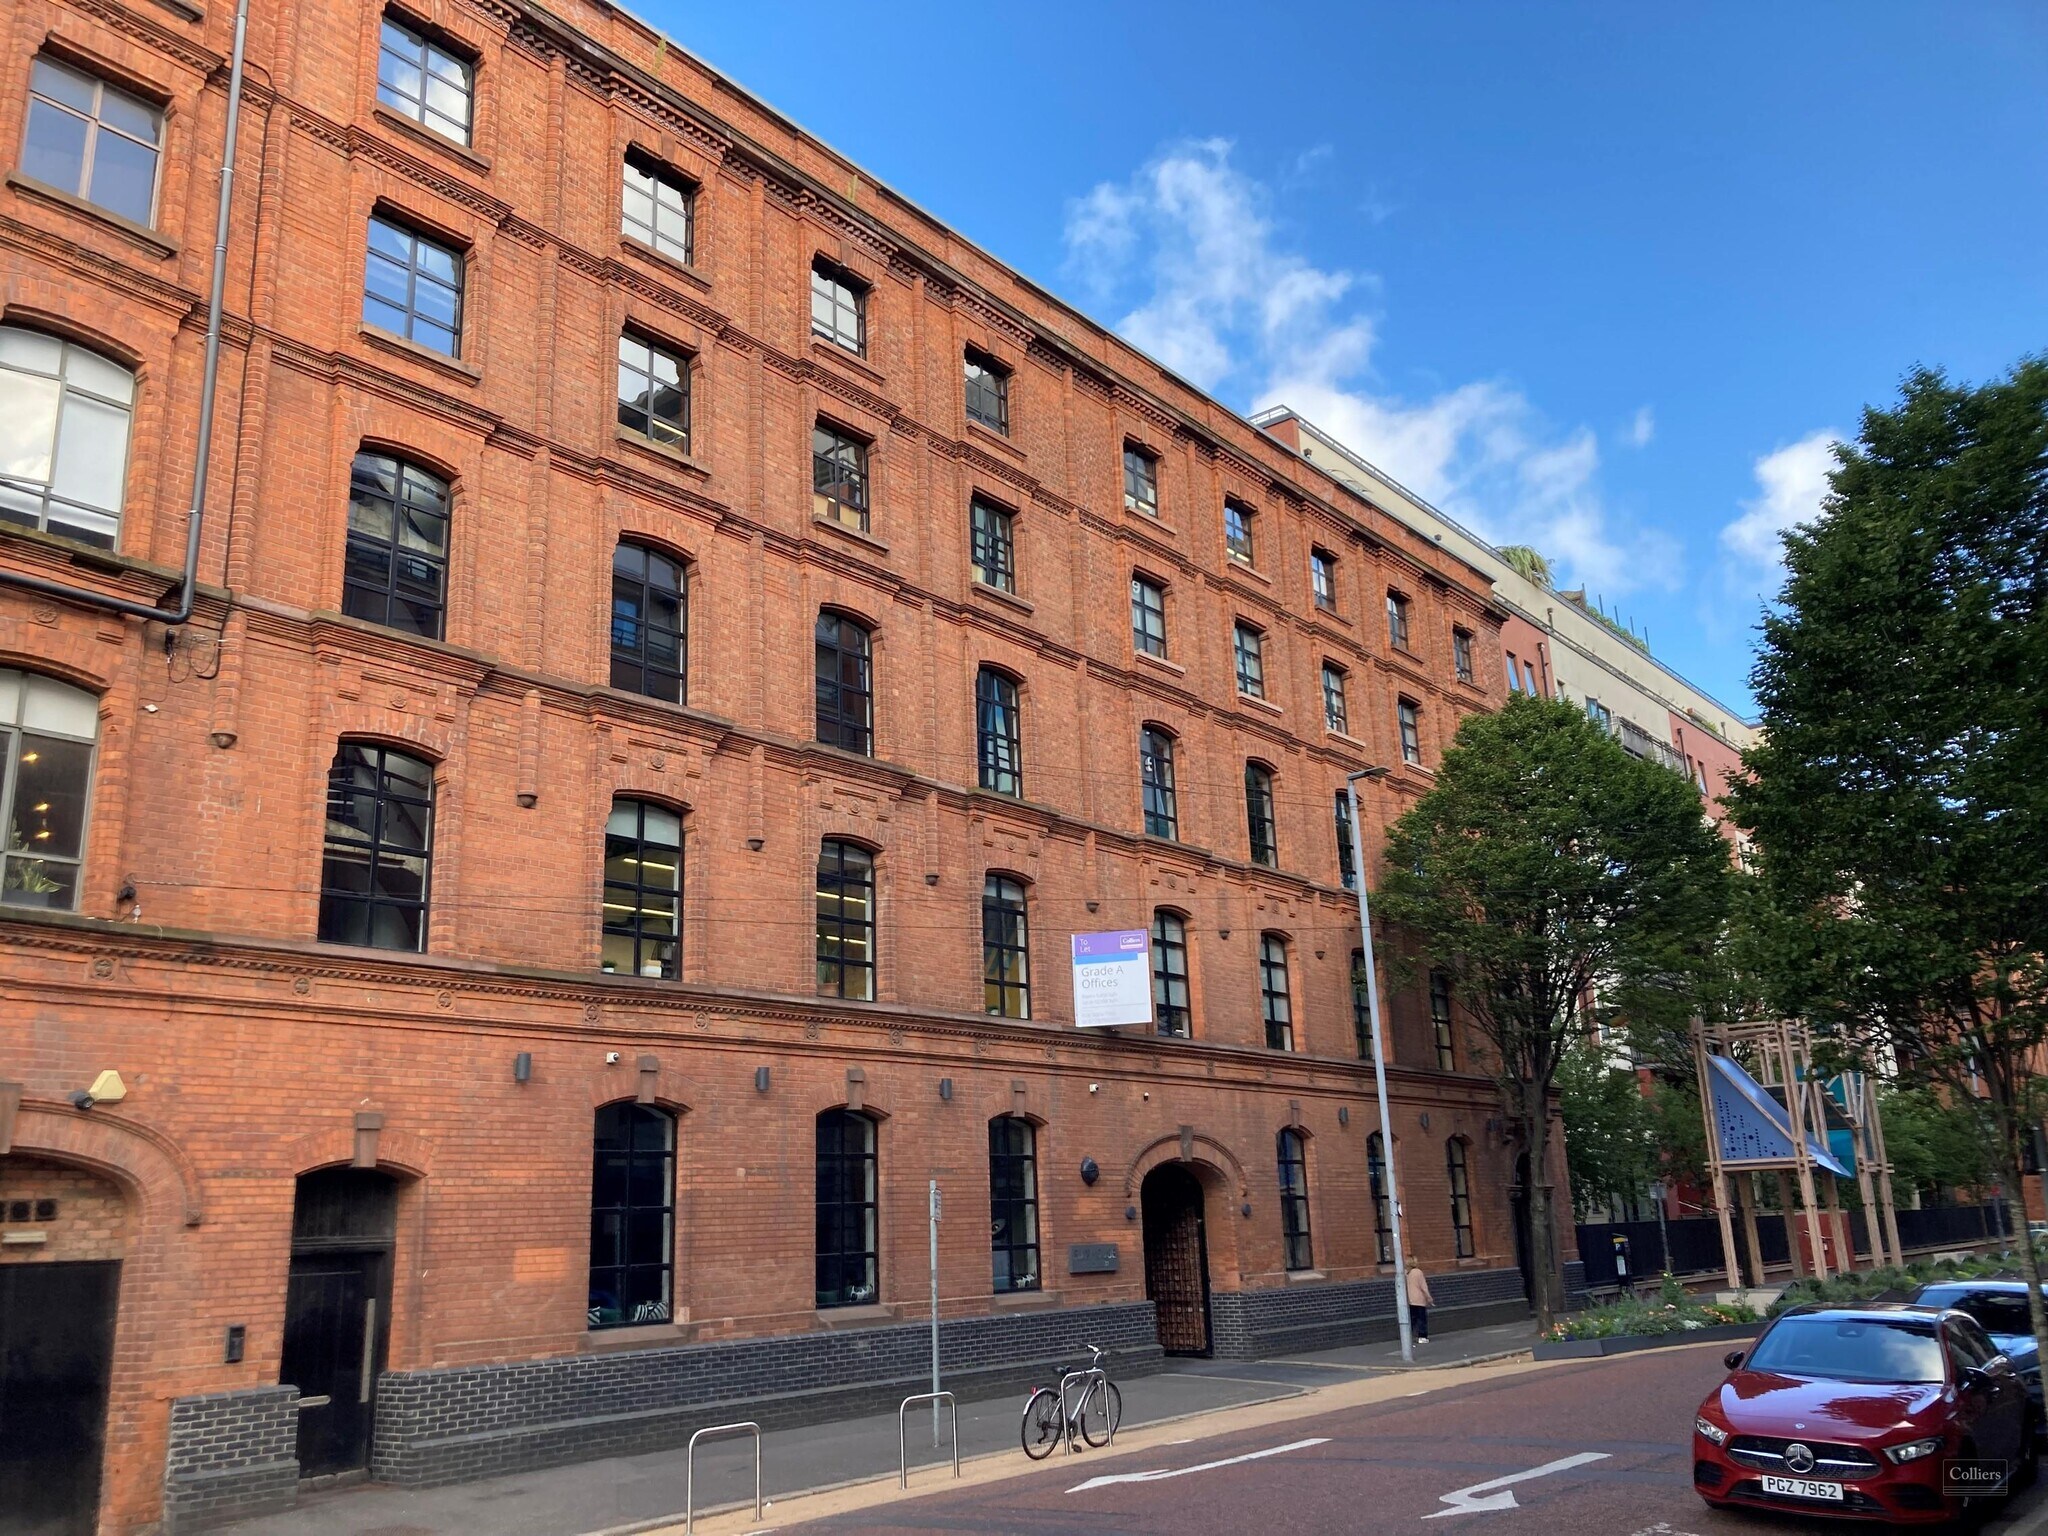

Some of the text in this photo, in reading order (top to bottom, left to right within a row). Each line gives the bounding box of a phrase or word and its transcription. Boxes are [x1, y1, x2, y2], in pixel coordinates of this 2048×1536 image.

[1080, 938, 1088, 946] To
[1081, 965, 1124, 977] Grade A
[1081, 978, 1118, 989] Offices
[1615, 1243, 1621, 1251] P
[1767, 1477, 1837, 1498] PGZ 7962
